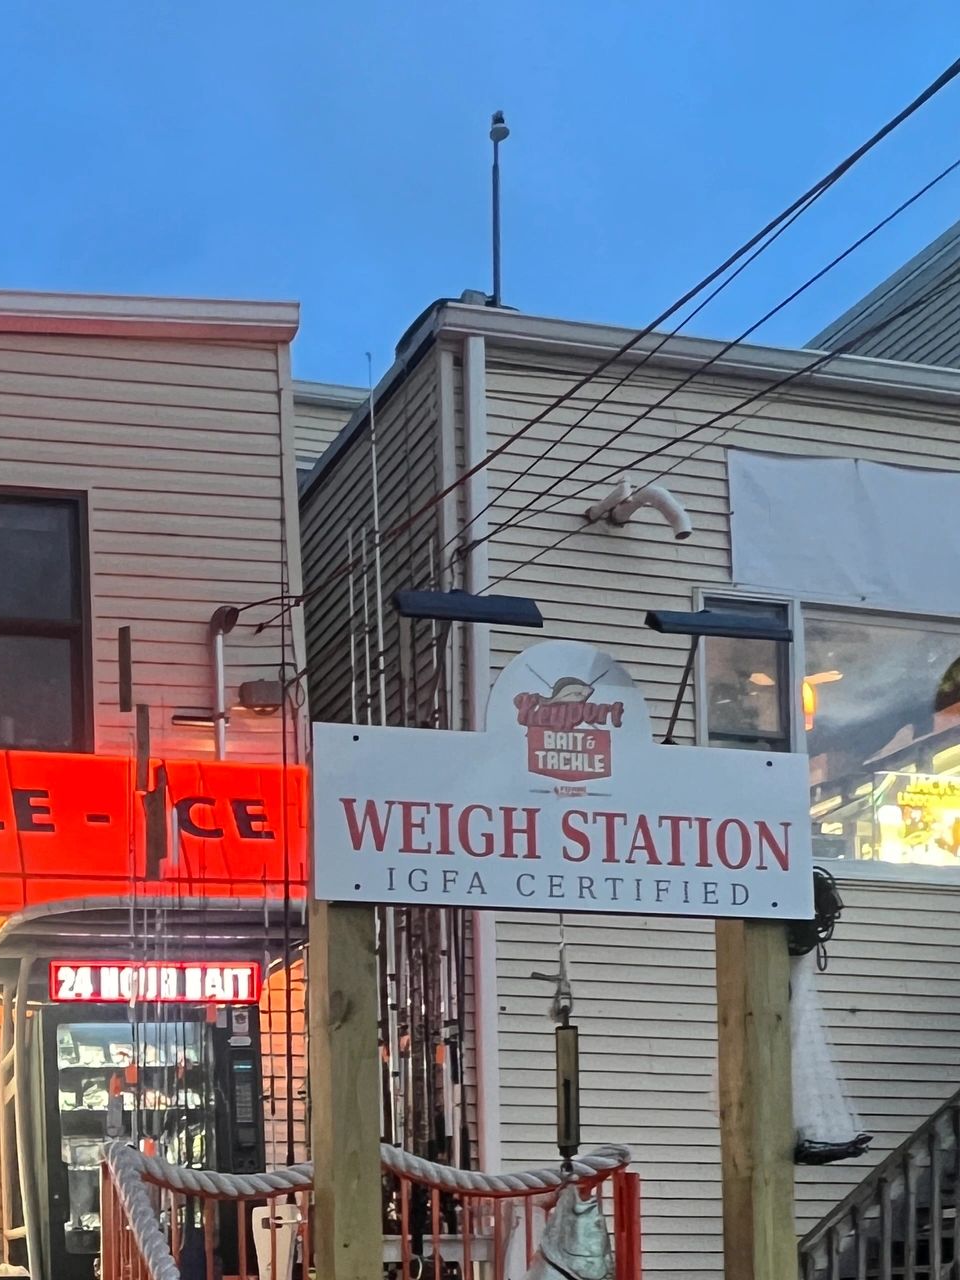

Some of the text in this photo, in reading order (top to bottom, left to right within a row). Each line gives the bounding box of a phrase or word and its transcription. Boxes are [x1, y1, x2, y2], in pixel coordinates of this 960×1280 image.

[543, 730, 585, 751] BAIT
[534, 751, 606, 773] TACKLE
[339, 797, 793, 872] WEIGH STATION
[386, 867, 751, 907] IGFA CERTIFIED
[57, 966, 252, 1001] 24 HOUR BAIT
